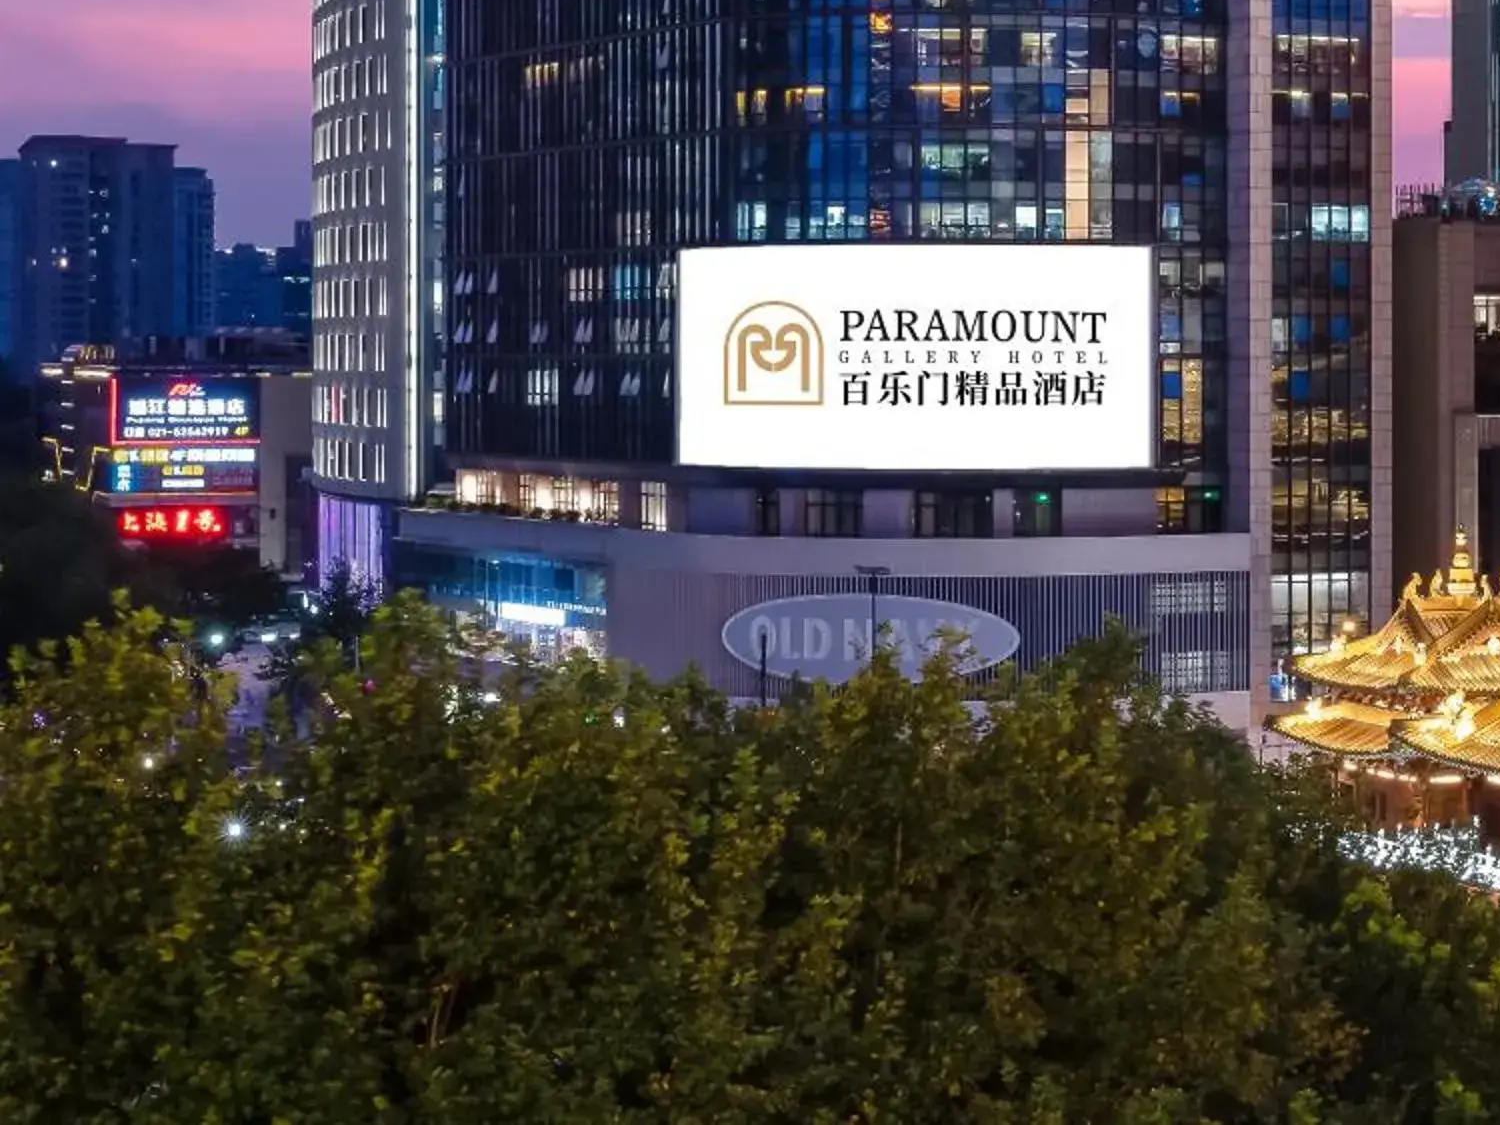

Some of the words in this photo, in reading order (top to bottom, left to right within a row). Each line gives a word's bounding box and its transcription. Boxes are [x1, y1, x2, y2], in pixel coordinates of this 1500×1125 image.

[839, 309, 1107, 343] PARAMOUNT
[838, 350, 981, 364] GALLERY
[1009, 350, 1107, 364] HOTEL
[840, 370, 1106, 406] 百乐门精品酒店
[752, 616, 833, 661] OLD
